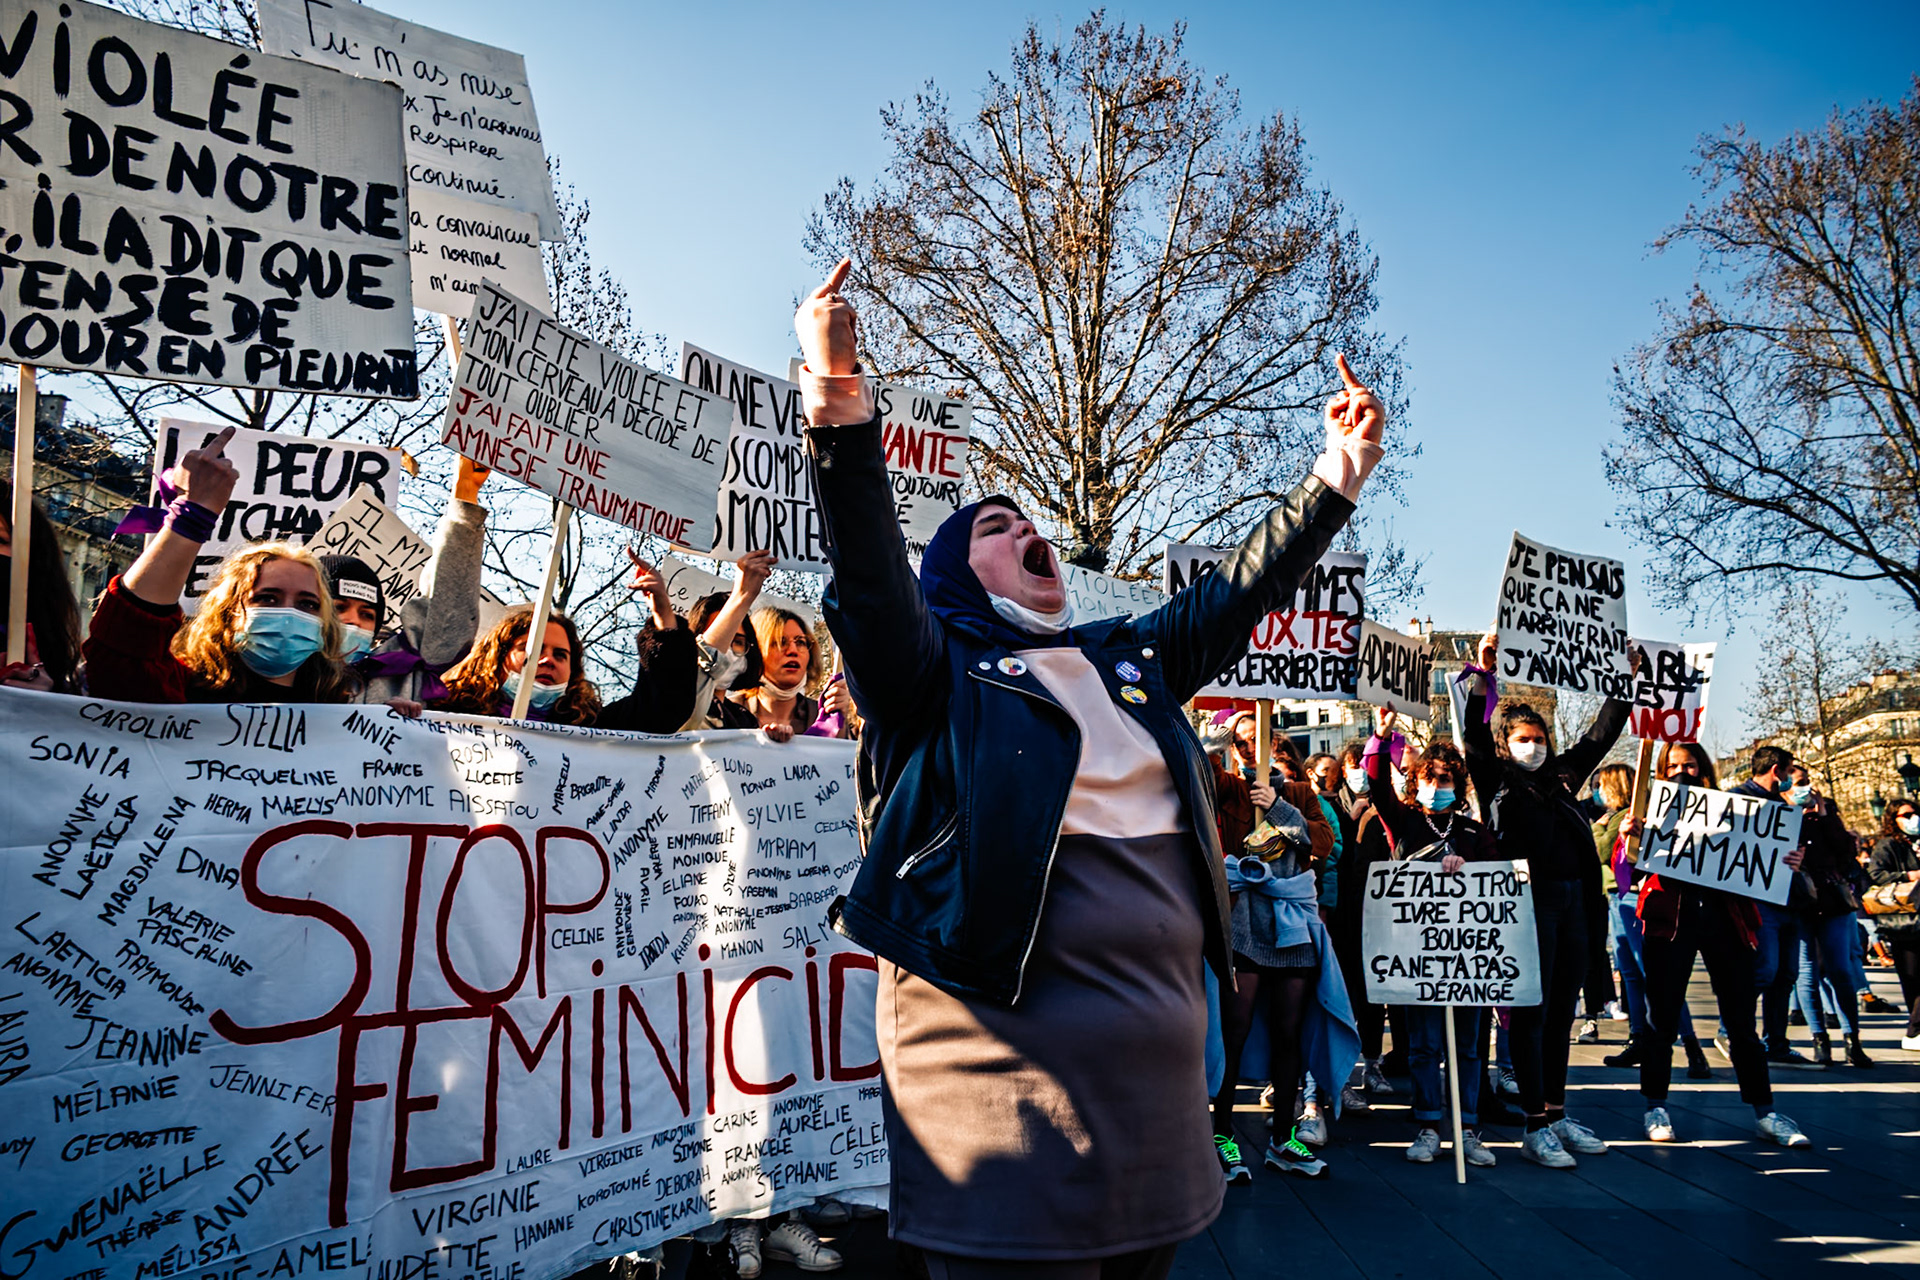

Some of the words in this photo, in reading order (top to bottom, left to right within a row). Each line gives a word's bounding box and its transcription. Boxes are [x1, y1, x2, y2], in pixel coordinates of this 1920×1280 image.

[460, 72, 522, 106] mise
[59, 108, 160, 191] DE
[166, 141, 403, 240] NOTRE
[436, 214, 538, 249] convaincue
[104, 206, 154, 270] A
[260, 240, 396, 310] QUE
[440, 244, 507, 270] normal
[223, 291, 300, 349] DE
[0, 307, 150, 375] OUR
[157, 335, 227, 379] EN
[479, 284, 529, 343] J'AI
[531, 319, 590, 377] ÉTÉ
[599, 352, 671, 416] VIOLÉE
[673, 389, 710, 429] ET
[465, 352, 519, 403] TOUT
[469, 319, 516, 369] MON
[516, 349, 604, 416] CERVEAU
[691, 434, 722, 465] DE
[455, 386, 503, 428] J'AI
[506, 412, 560, 454] FAIT
[563, 437, 612, 480] UNE
[911, 396, 964, 430] UNE
[252, 440, 390, 505] PEUR
[442, 417, 548, 490] AMNÉSIE
[556, 467, 695, 547] TRAUMATIQUE
[350, 499, 384, 545] IL
[1508, 537, 1541, 579] JE
[1544, 550, 1625, 600] PENSAIS
[1502, 575, 1537, 608] QUE
[1574, 593, 1605, 623] NE
[1503, 647, 1589, 693] J'AVAIS
[1634, 679, 1698, 711] EST
[79, 702, 201, 740] CAROLINE
[217, 703, 306, 752] STELLA
[342, 709, 403, 756] ANNIE
[29, 735, 130, 780] SONIA
[184, 758, 338, 787] JACQUELINE
[362, 758, 424, 780] FRANCE
[465, 769, 524, 786] LUCETTE
[783, 763, 821, 782] LAURA
[261, 795, 336, 820] MAELYS
[335, 784, 435, 808] ANONYME
[747, 802, 807, 831] SYLVIE
[1655, 786, 1709, 827] PAPA
[1717, 797, 1735, 830] A
[31, 783, 110, 888] ANONYME
[611, 804, 670, 873] ANONYME
[667, 826, 736, 851] EMMANUELLE
[756, 837, 817, 862] MYRIAM
[97, 795, 197, 927] MAGDALENA
[176, 845, 240, 891] DINA
[673, 850, 729, 871] MONIQUE
[1642, 824, 1779, 892] MAMAN
[1370, 862, 1467, 900] J'ÉTAIS
[1471, 870, 1531, 898] TROP
[207, 818, 611, 1045] STOP
[1391, 900, 1451, 925] IVRE
[1457, 900, 1519, 924] POUR
[14, 911, 128, 1001] LAETICIA
[136, 917, 254, 978] PASCALINE
[551, 926, 606, 950] CELINE
[720, 937, 765, 961] MANON
[115, 937, 206, 1017] RAYMONDE
[1370, 954, 1407, 984] ÇA
[1469, 954, 1521, 980] PAS
[1414, 979, 1515, 1004] DÉRANGÉ
[64, 1012, 210, 1068] JEANINE
[52, 1074, 181, 1124] MÉLANIE
[209, 1063, 338, 1117] JENNIFER
[713, 1109, 759, 1133] CARINE
[778, 1104, 853, 1138] AURÉLIE
[61, 1125, 202, 1162] GEORGETTE
[506, 1148, 553, 1175] LAURE
[578, 1143, 645, 1178] VIRGINIE
[192, 1127, 326, 1241] ANDRÉE
[654, 1164, 712, 1202] DEBORAH
[754, 1160, 840, 1198] STÉPHANIE
[412, 1179, 541, 1237] VIRGINIE
[514, 1213, 575, 1253] HANANE
